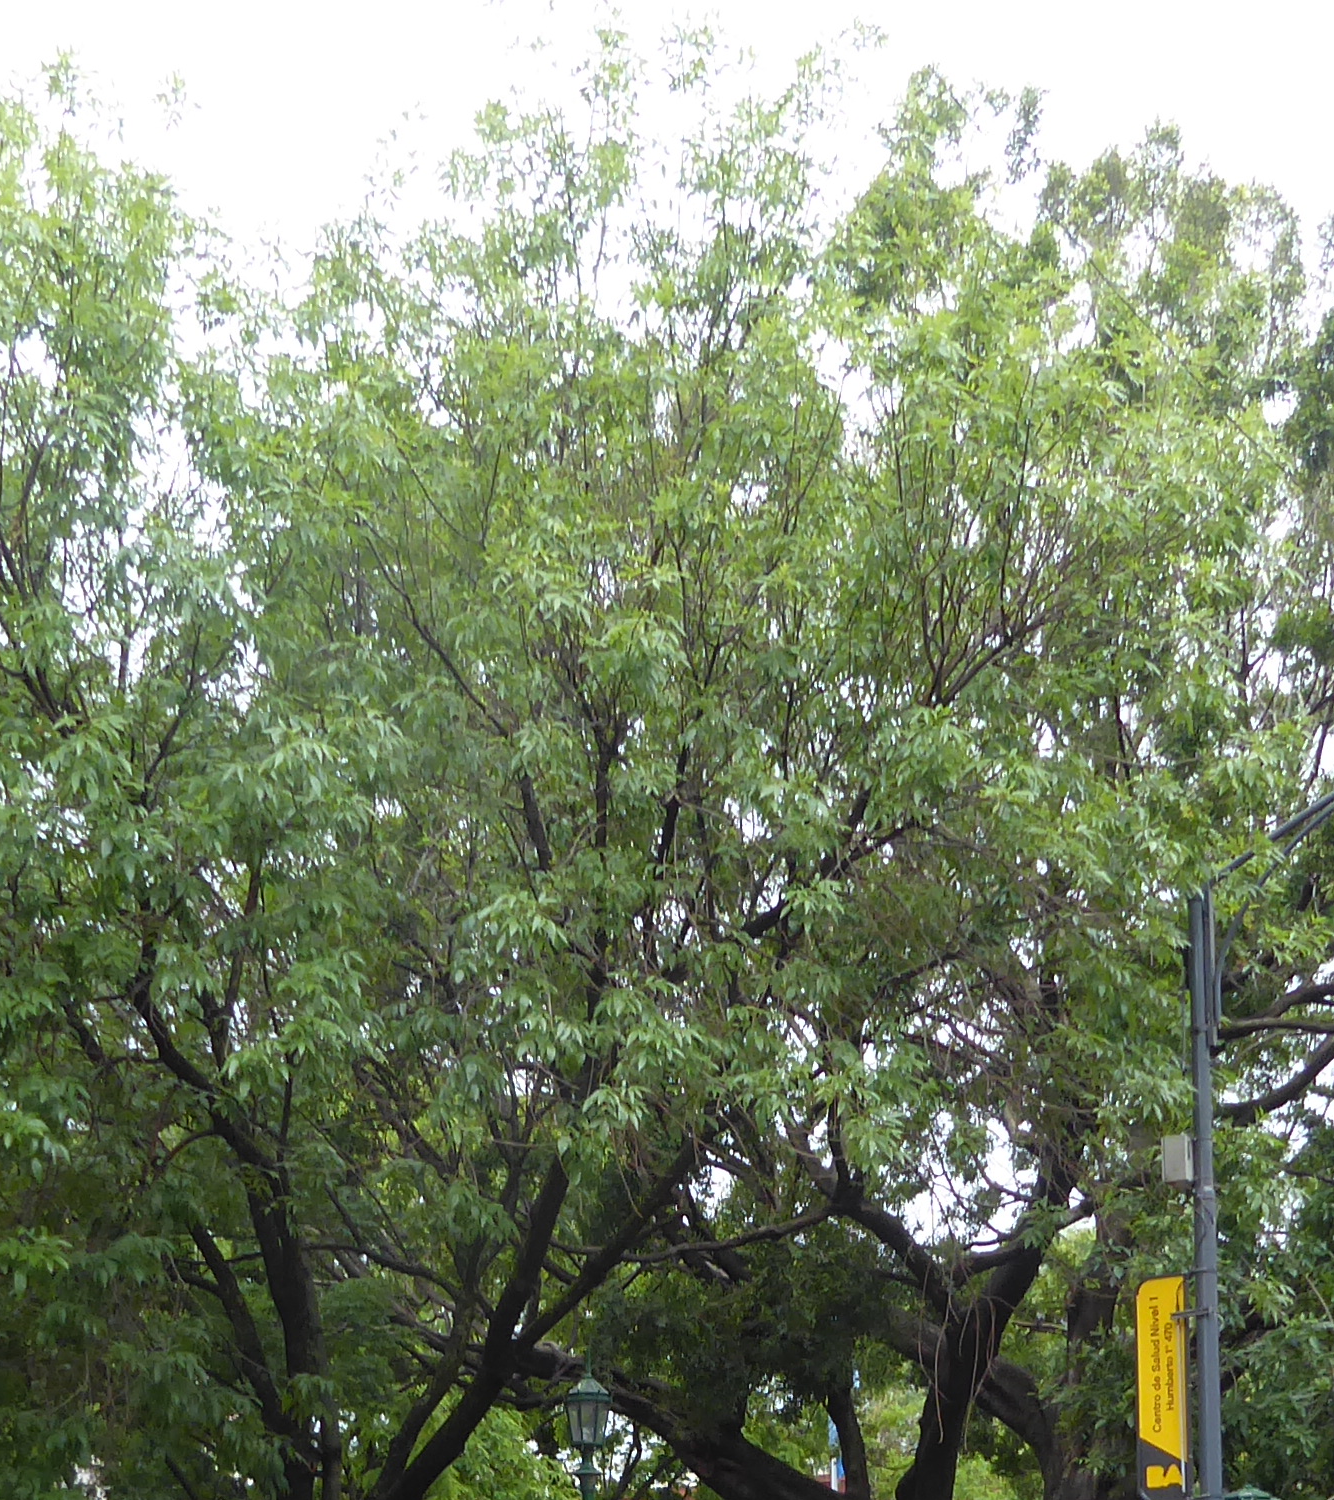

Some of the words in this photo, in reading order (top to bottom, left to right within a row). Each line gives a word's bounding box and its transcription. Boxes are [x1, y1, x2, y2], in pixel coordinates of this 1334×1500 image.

[1149, 1305, 1160, 1337] Nivel
[1163, 1322, 1173, 1342] 470
[1151, 1339, 1161, 1372] Salud
[1151, 1376, 1161, 1391] de
[1165, 1356, 1175, 1411] Humberto
[1152, 1394, 1162, 1433] Centro
